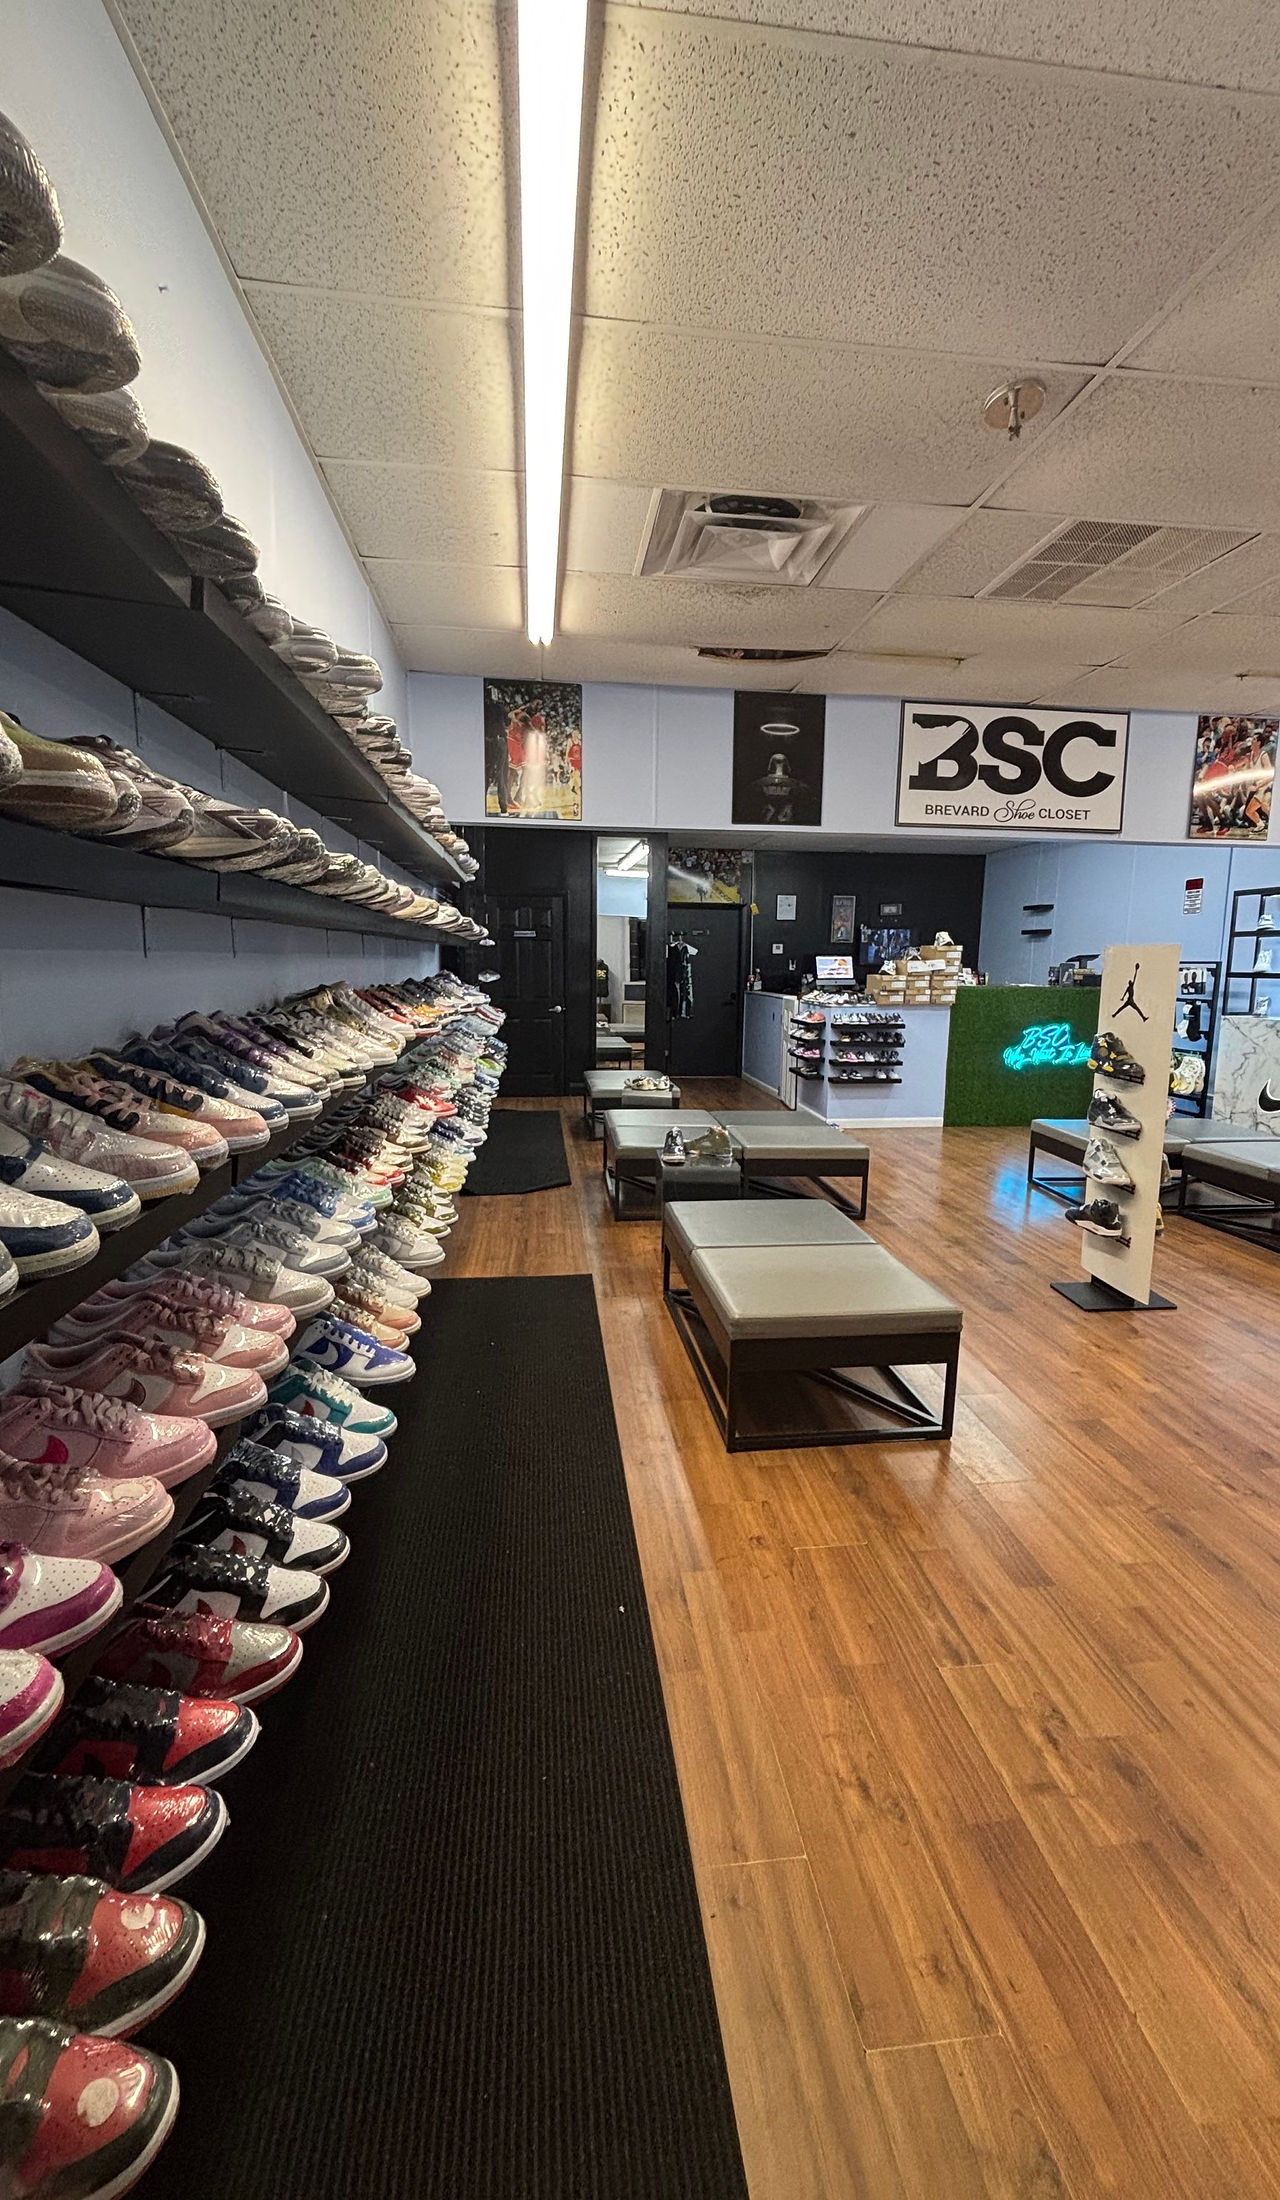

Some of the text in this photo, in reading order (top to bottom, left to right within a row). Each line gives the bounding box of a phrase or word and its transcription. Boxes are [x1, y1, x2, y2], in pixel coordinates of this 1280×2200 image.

[909, 713, 1117, 798] BSC
[924, 798, 1091, 823] BREVARD Shoe CLOSET
